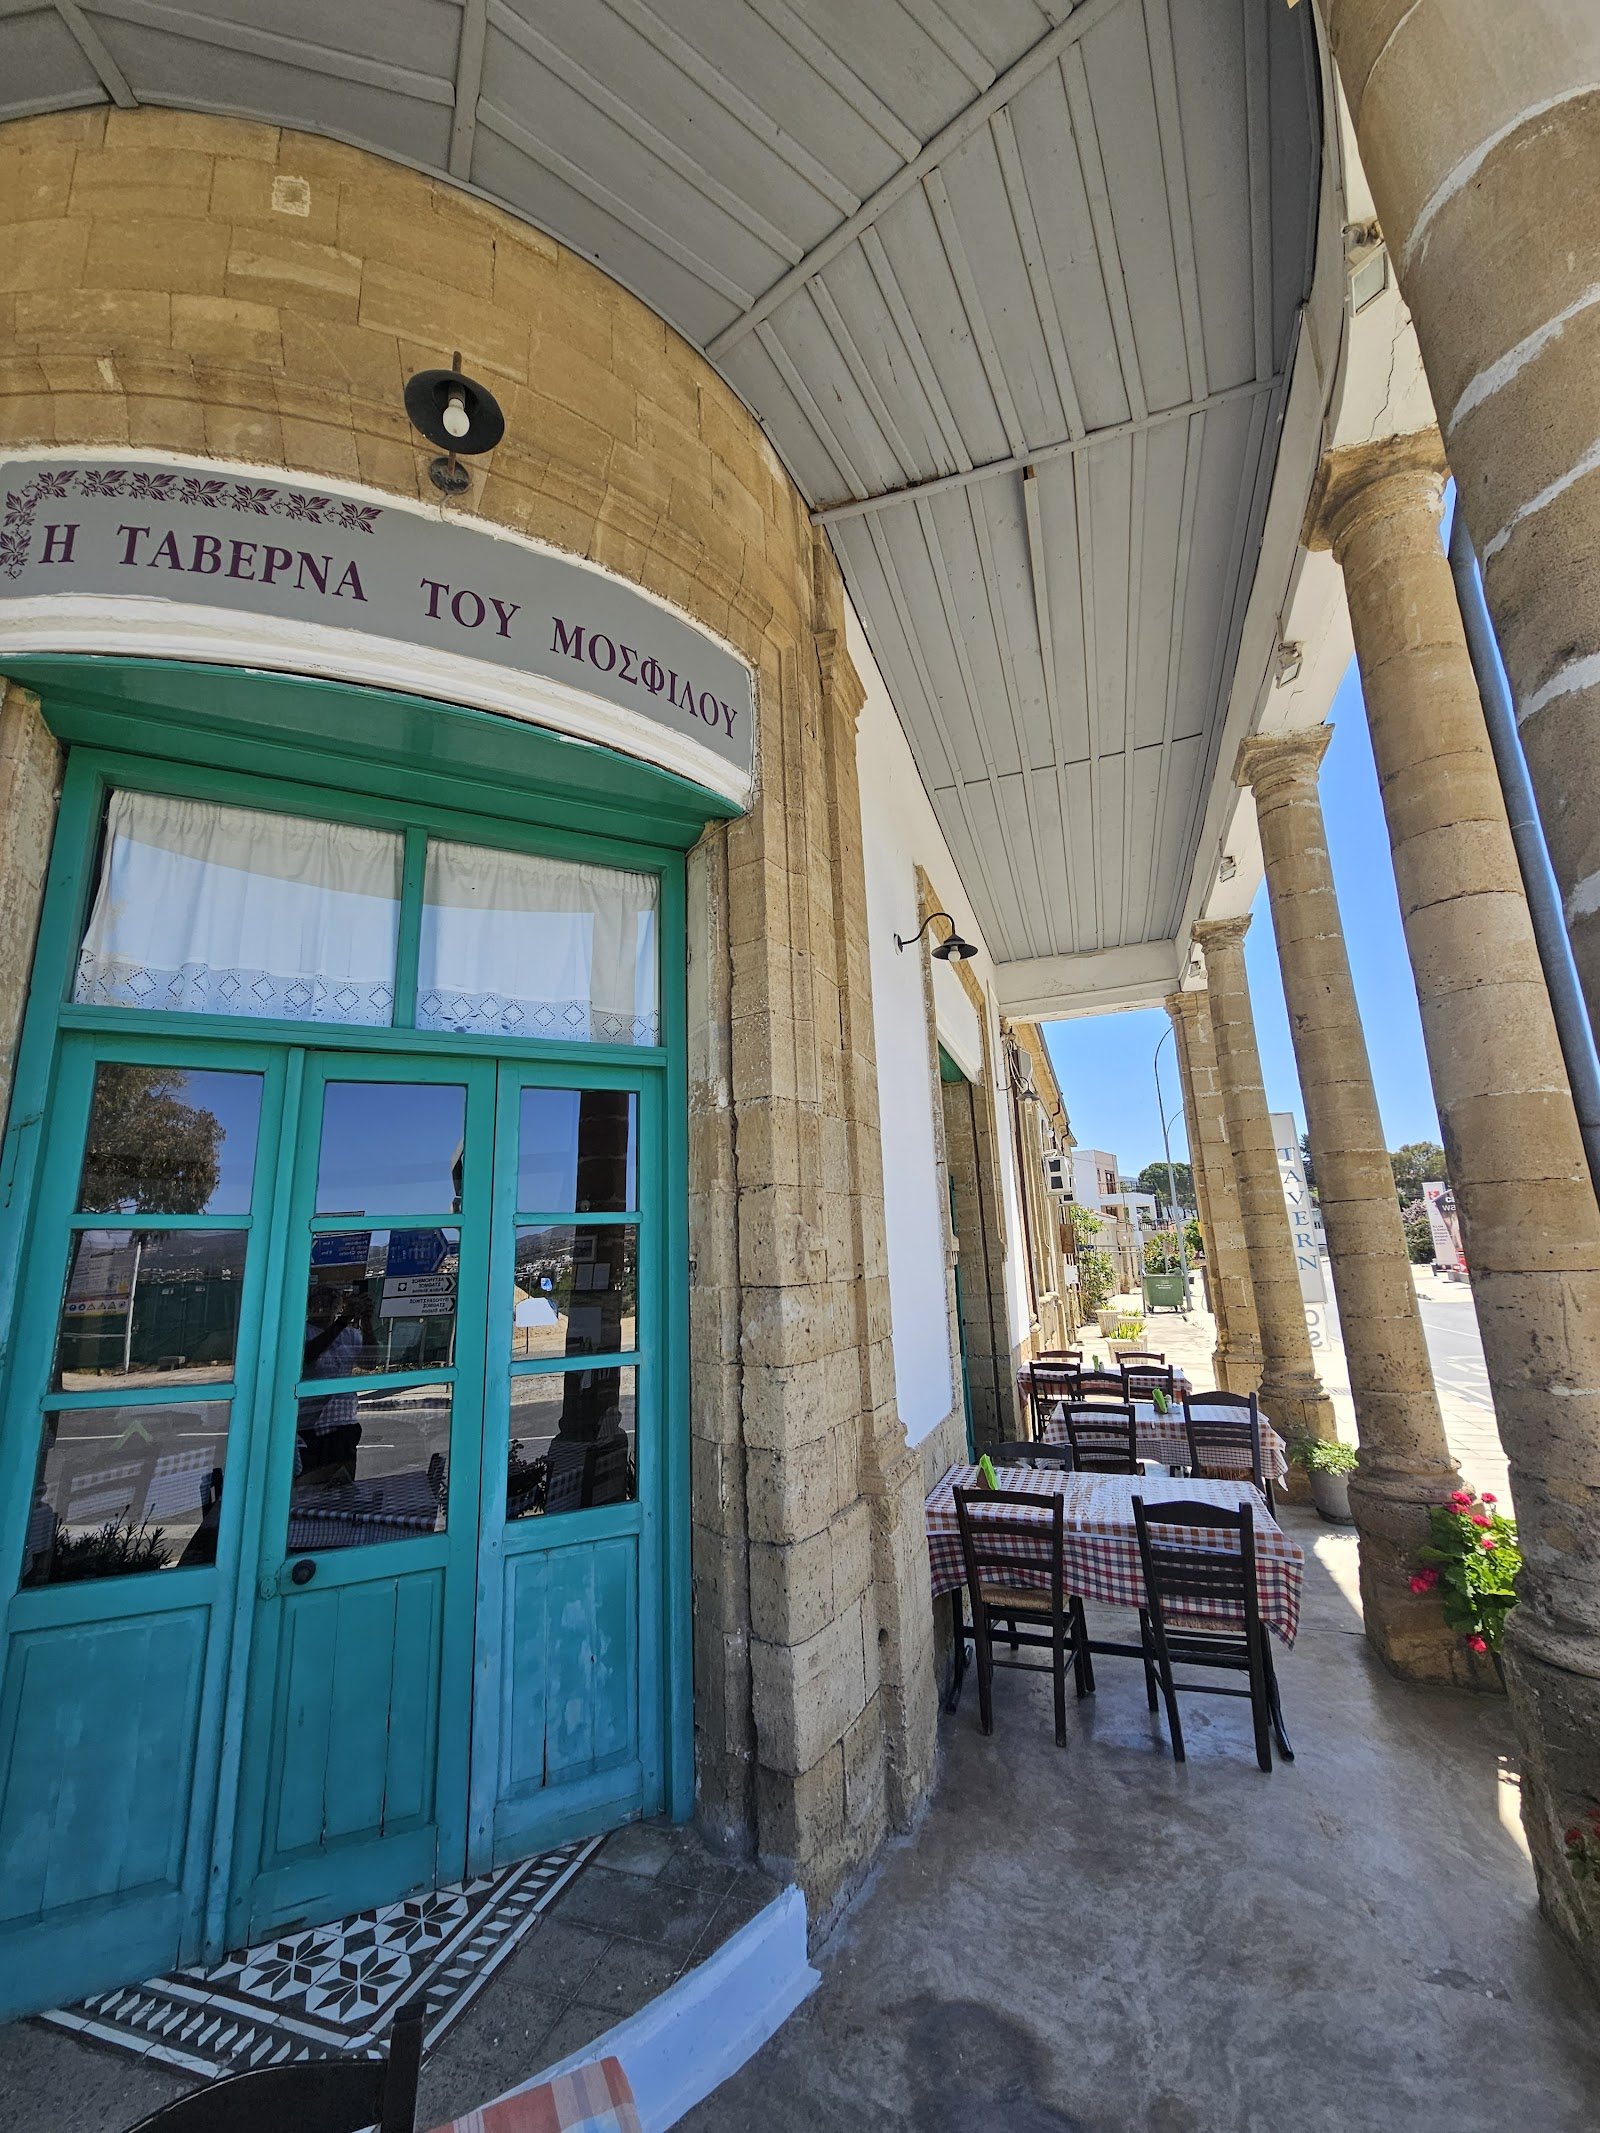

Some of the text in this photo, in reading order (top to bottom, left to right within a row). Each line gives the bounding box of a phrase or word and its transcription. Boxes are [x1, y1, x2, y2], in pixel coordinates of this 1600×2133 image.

[38, 523, 738, 739] Η ΤΑΒΕΡΝΑ ΤΟΥ ΜΟΣΦΙΛΟΥ
[1277, 1146, 1319, 1271] TAVERN
